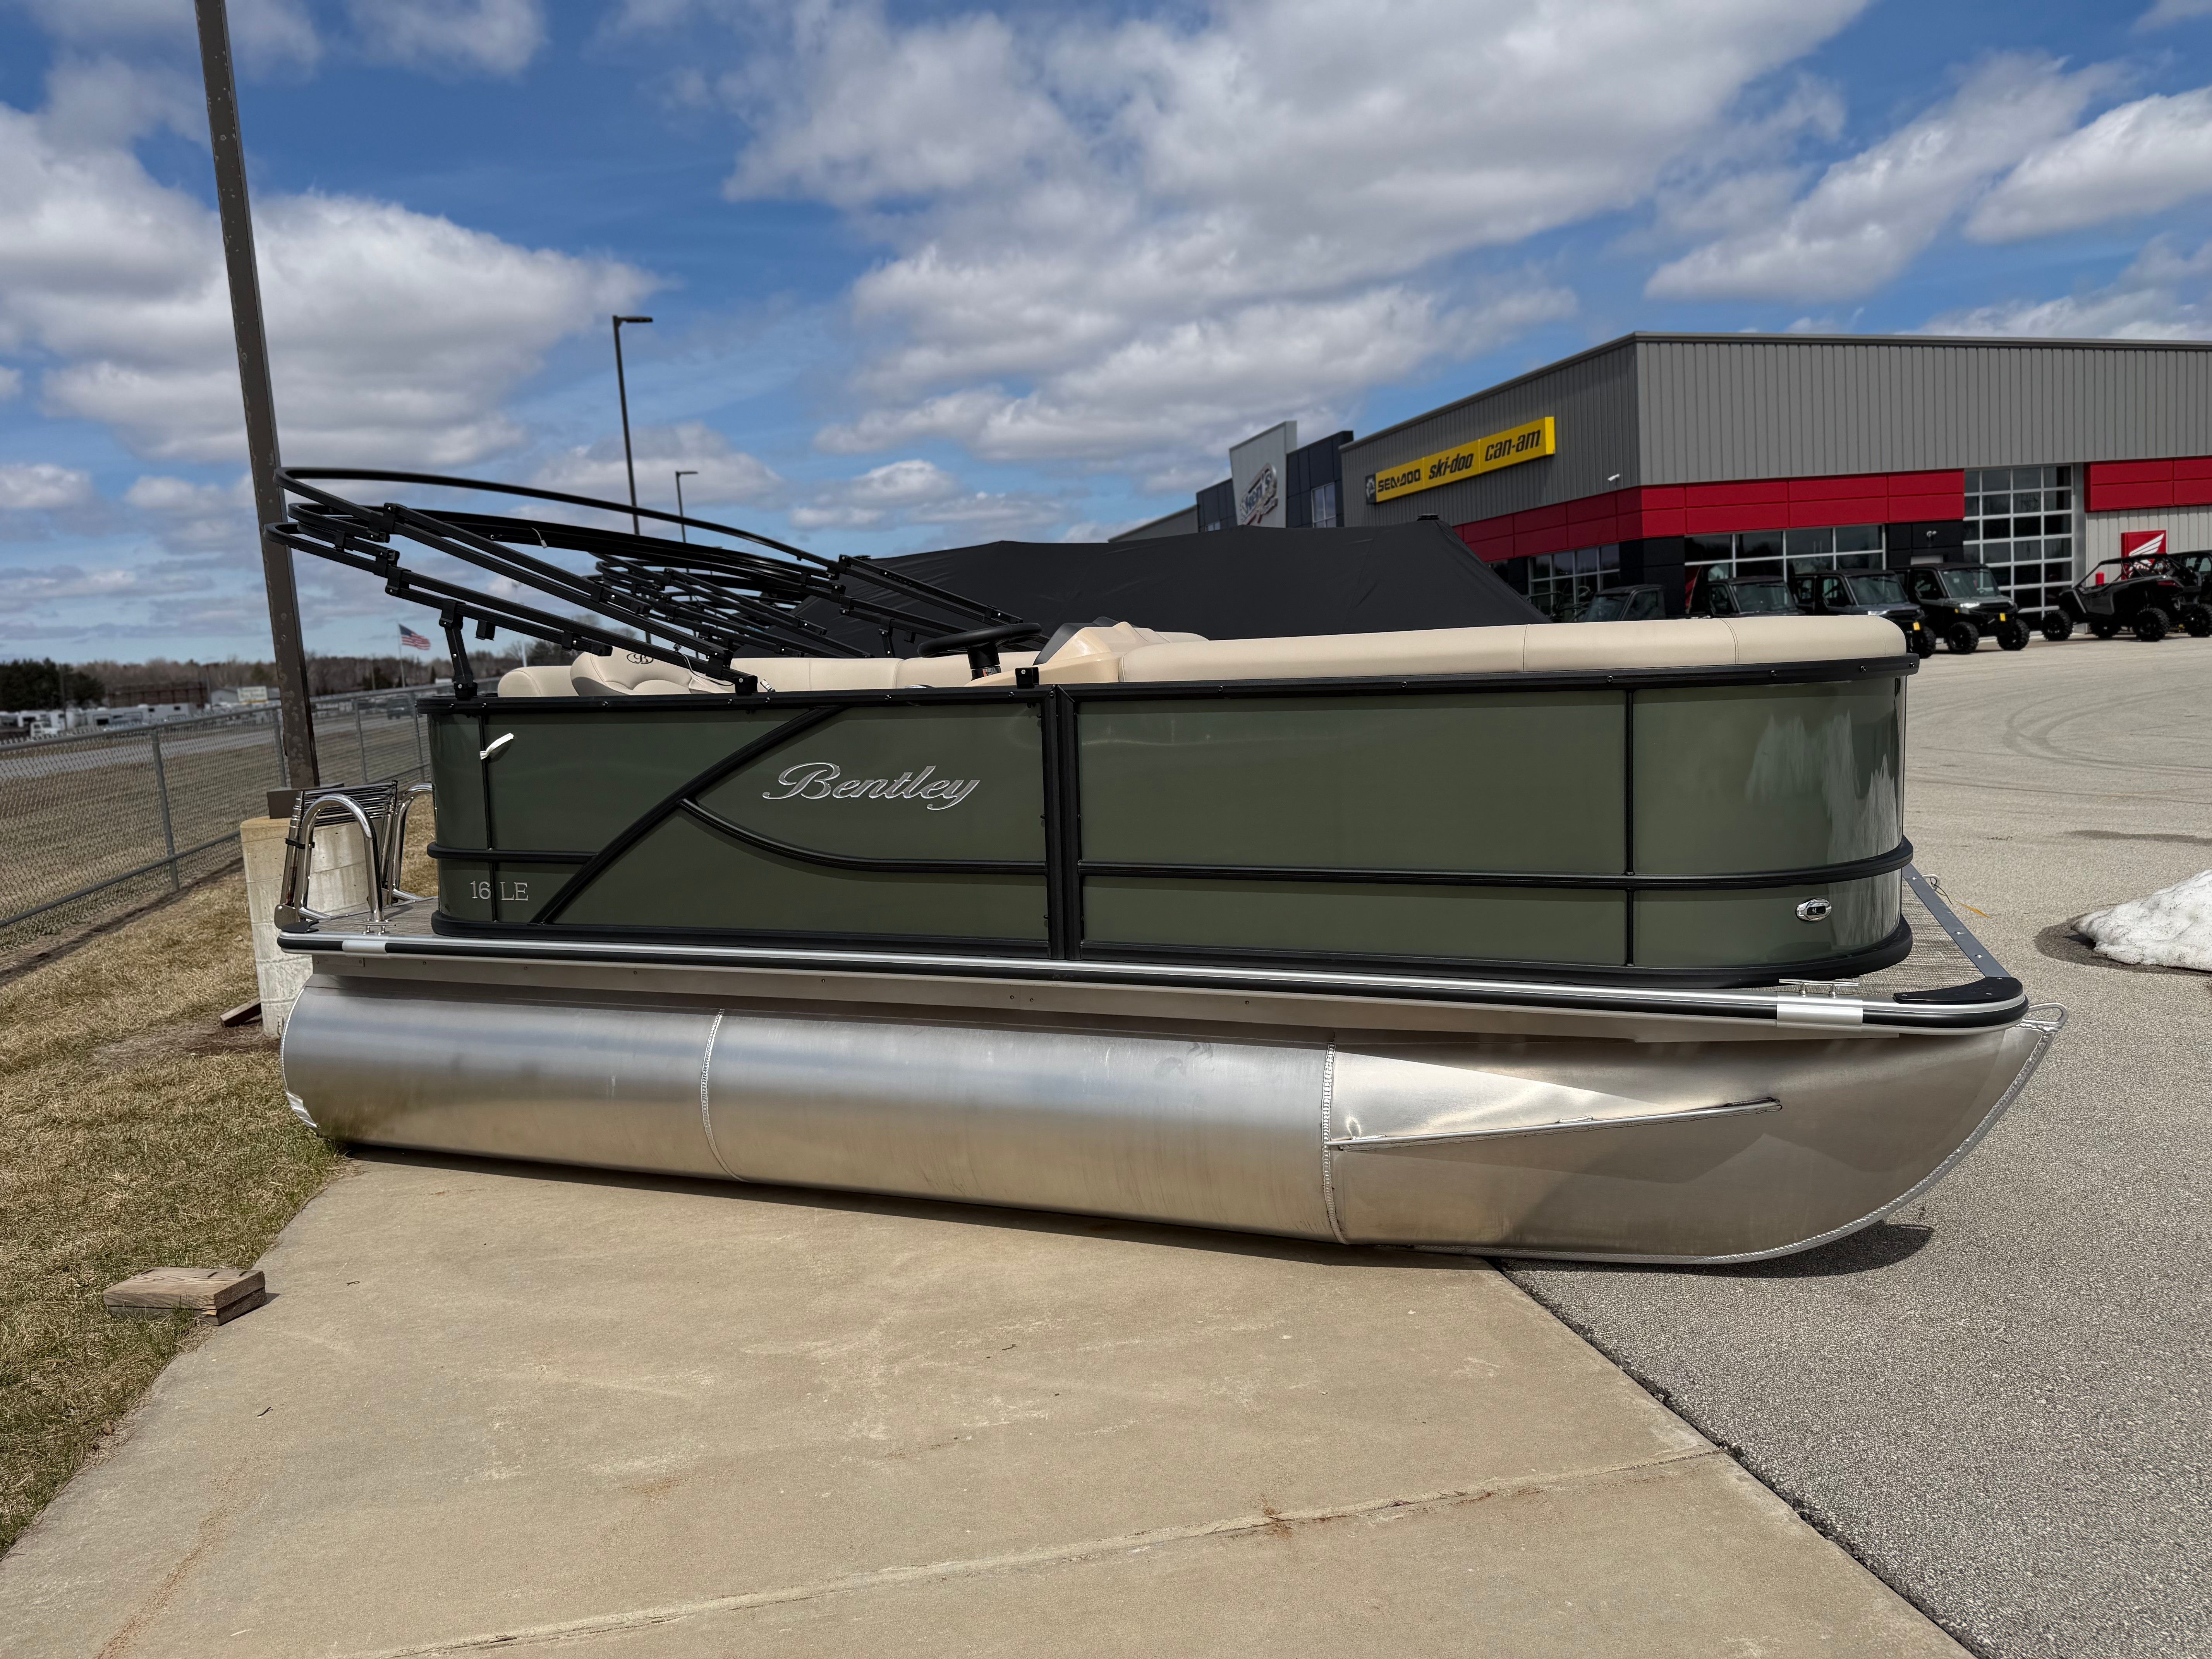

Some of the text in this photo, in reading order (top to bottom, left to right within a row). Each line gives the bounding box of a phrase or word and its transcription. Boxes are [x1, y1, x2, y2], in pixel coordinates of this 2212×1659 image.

[1429, 453, 1474, 480] ski-doo
[1485, 429, 1541, 462] can-am
[762, 762, 980, 810] Bentley
[470, 881, 529, 901] 16 LE
